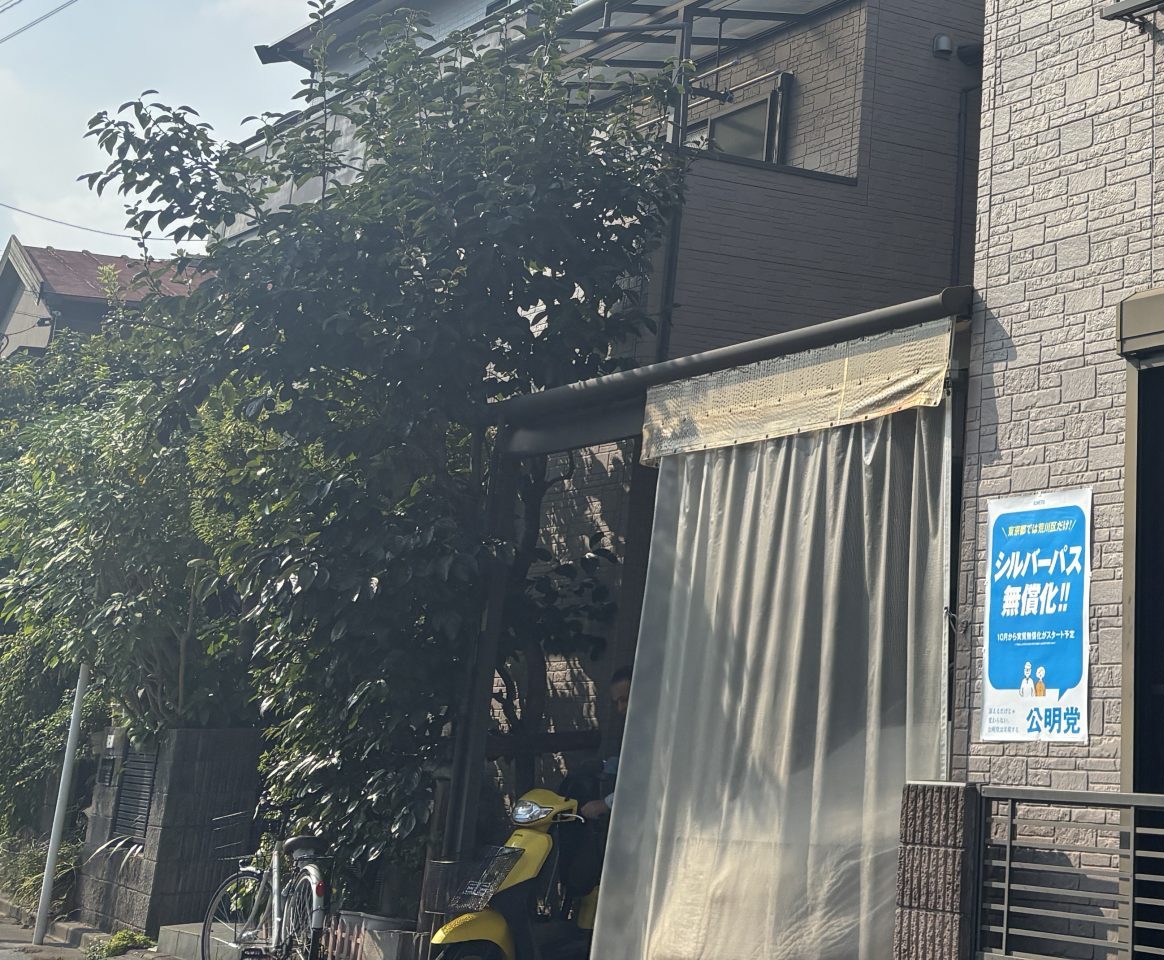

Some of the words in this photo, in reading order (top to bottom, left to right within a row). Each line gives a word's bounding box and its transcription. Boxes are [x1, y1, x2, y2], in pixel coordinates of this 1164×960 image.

[994, 545, 1082, 582] シルバーパス
[1001, 582, 1071, 617] 無償化!!
[1026, 706, 1081, 734] 公明党
